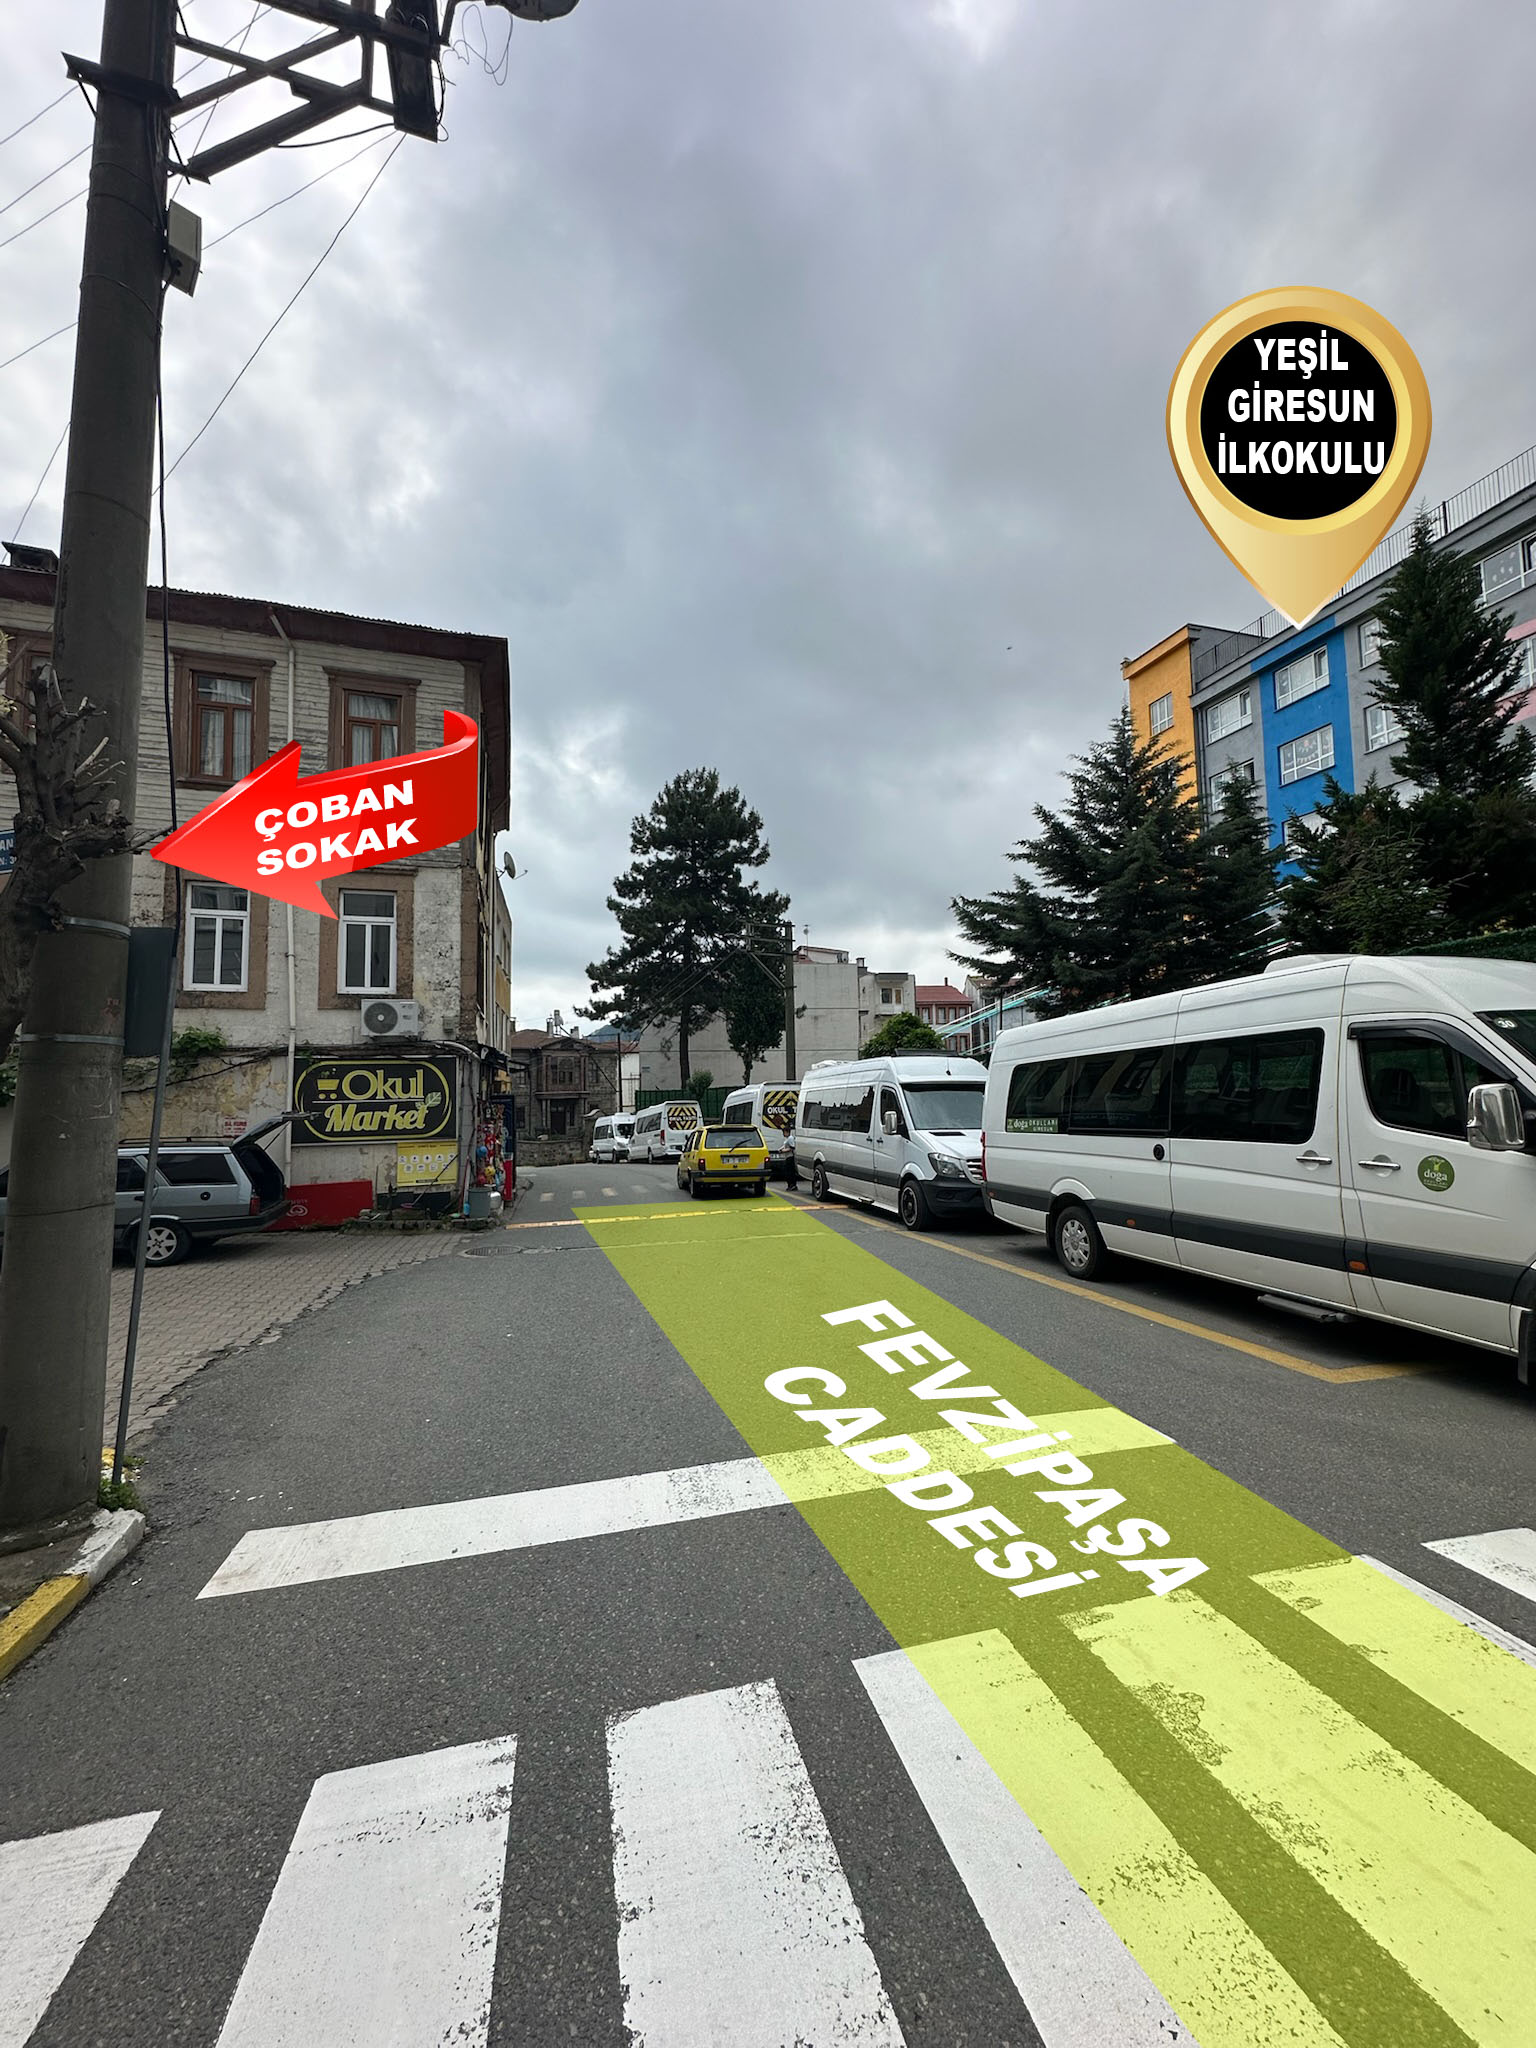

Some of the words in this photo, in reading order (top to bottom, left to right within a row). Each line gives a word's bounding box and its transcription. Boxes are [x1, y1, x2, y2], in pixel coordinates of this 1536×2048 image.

[341, 1069, 425, 1100] Okul
[324, 1103, 429, 1132] Market
[767, 1106, 788, 1114] OKUL
